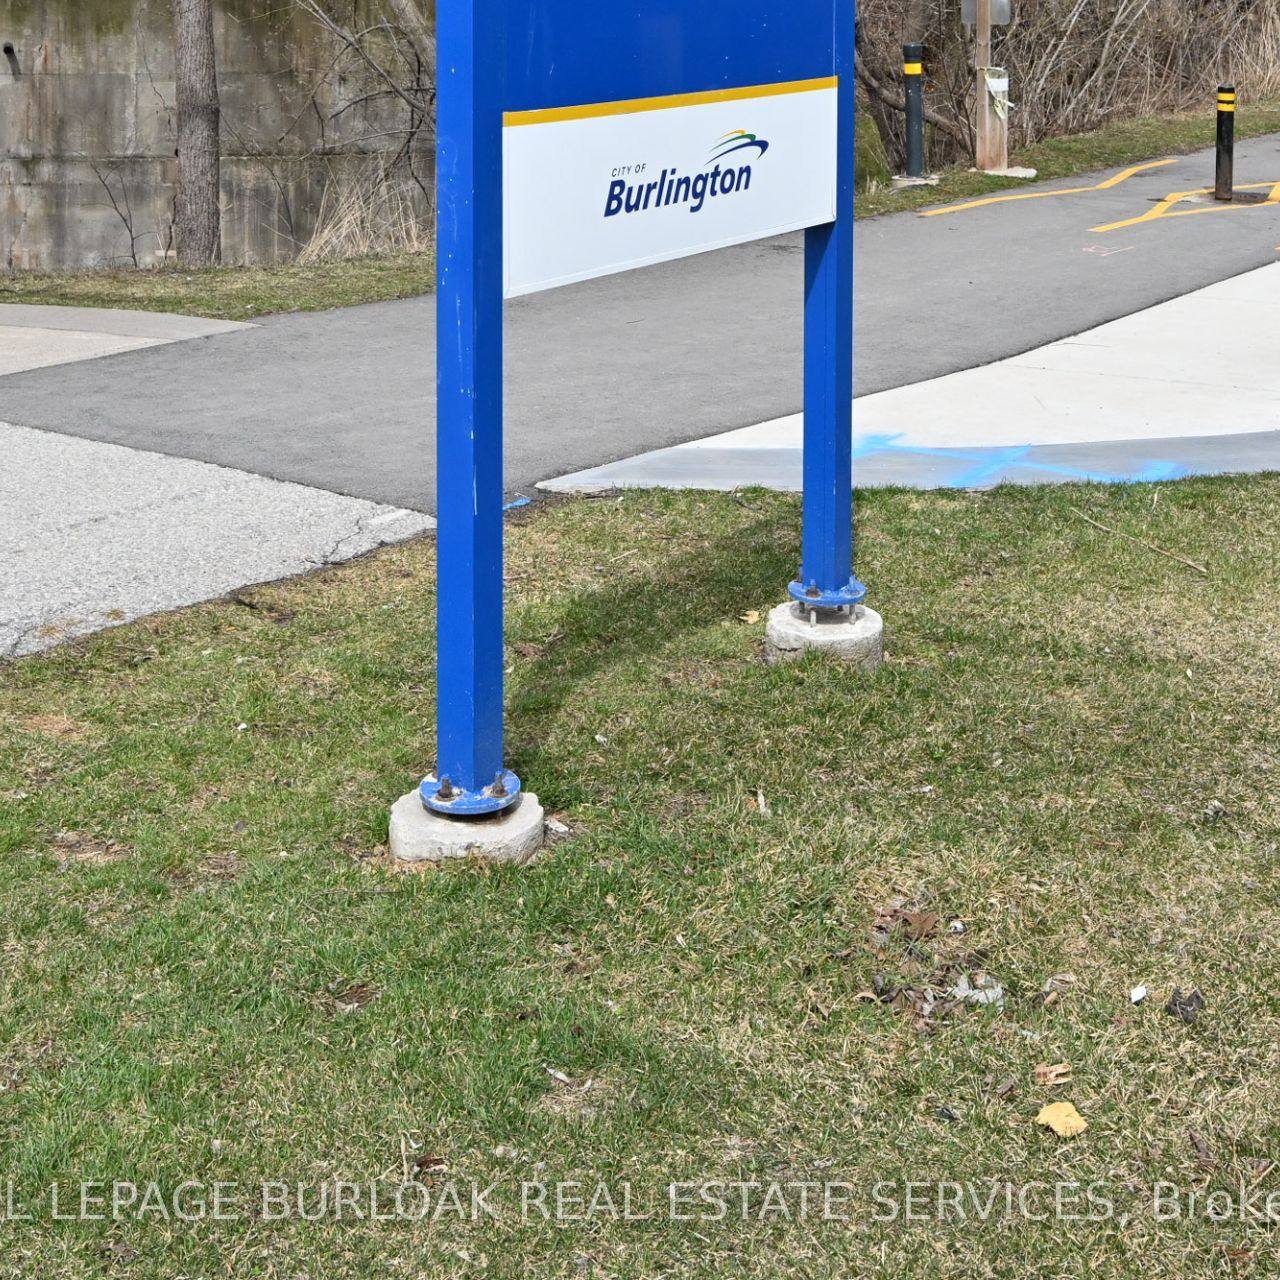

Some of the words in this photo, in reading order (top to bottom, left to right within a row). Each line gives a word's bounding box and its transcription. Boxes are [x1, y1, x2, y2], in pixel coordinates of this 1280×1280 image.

[611, 166, 632, 178] CITY
[634, 163, 647, 174] OF
[603, 163, 752, 218] Burlington
